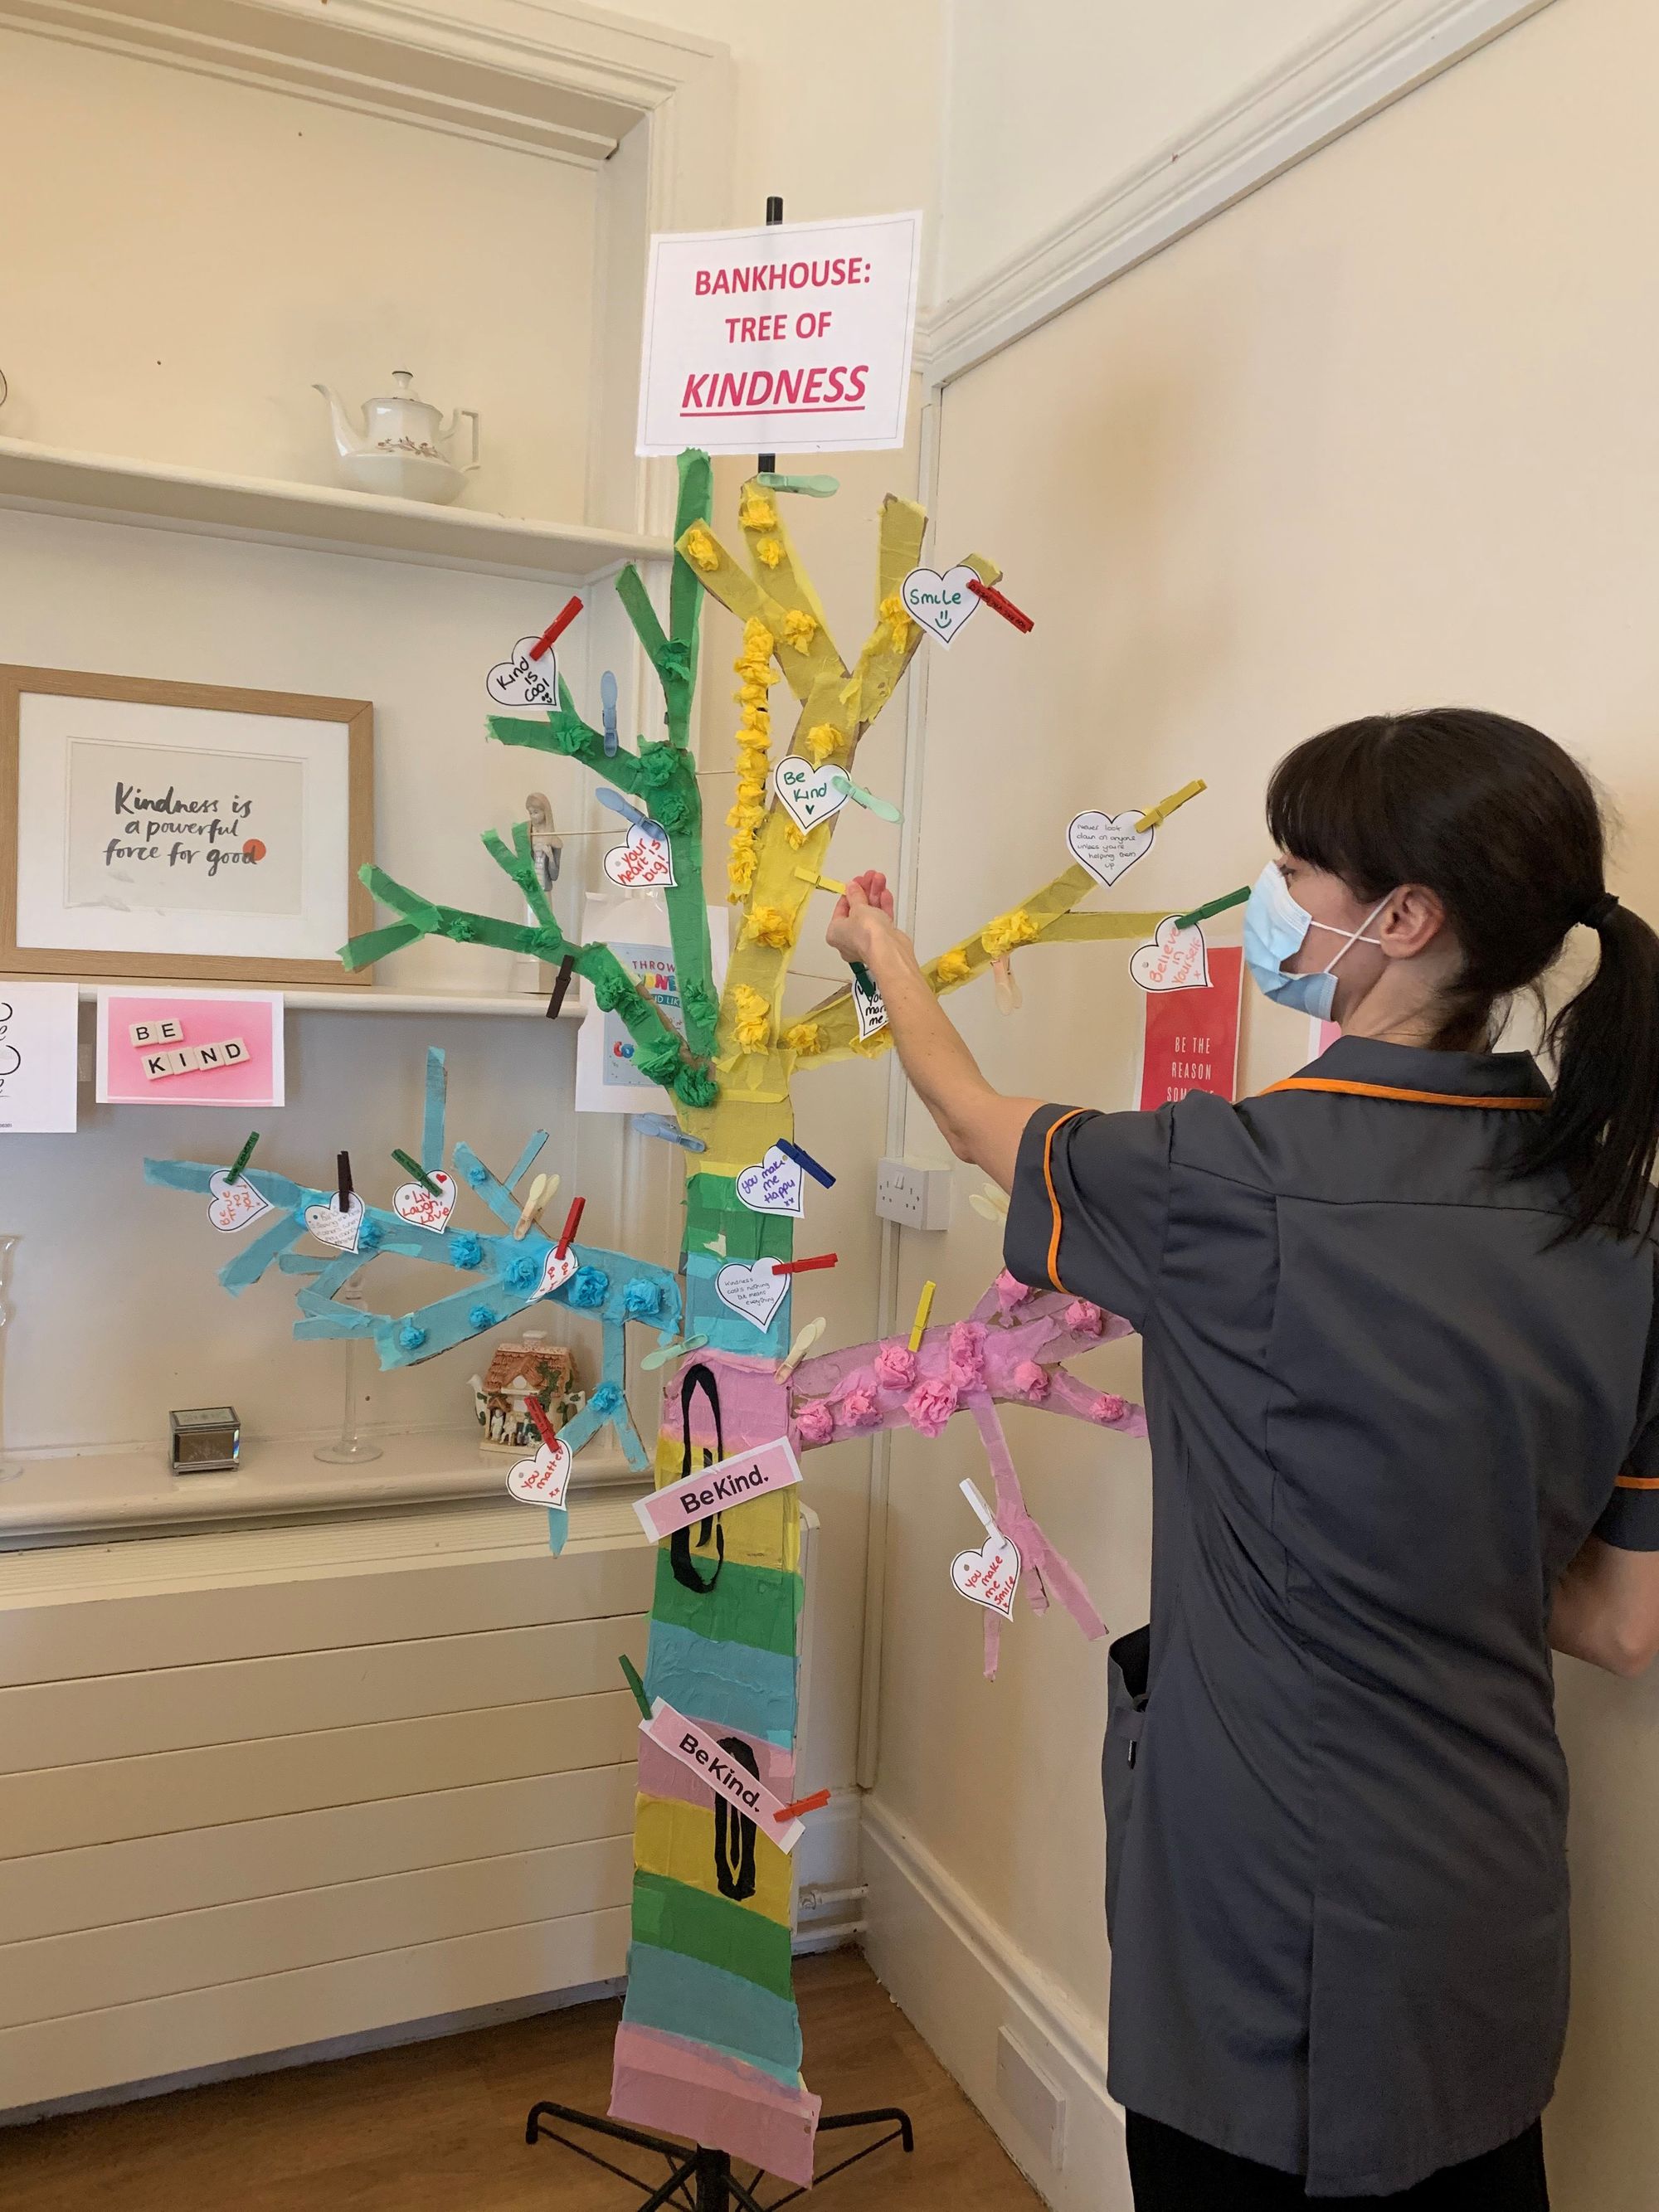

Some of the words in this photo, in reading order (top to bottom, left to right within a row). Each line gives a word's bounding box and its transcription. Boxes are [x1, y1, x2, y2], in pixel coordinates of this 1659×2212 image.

[695, 257, 871, 296] BANKHOUSE:
[725, 314, 787, 343] TREE
[795, 311, 832, 339] OF
[681, 365, 869, 408] KINDNESS
[496, 656, 529, 690] Kind
[524, 671, 538, 685] is
[784, 771, 805, 785] Be
[114, 781, 219, 814] Kindness
[231, 795, 252, 818] is
[794, 782, 827, 802] Kind
[124, 819, 140, 834] a
[146, 818, 238, 843] powerful
[1110, 836, 1136, 844] anyone
[103, 839, 161, 866] force
[168, 842, 201, 867] for
[207, 844, 258, 877] good
[617, 857, 649, 885] heart
[649, 839, 661, 855] is
[1088, 853, 1115, 862] helping
[1149, 927, 1181, 983] Believe
[1172, 951, 1185, 965] in
[632, 960, 676, 972] THROW
[869, 1015, 883, 1026] me
[136, 1023, 176, 1040] BE
[1175, 1037, 1186, 1053] BE
[1193, 1037, 1210, 1053] THE
[148, 1043, 241, 1074] KIND
[1172, 1062, 1211, 1080] REASON
[421, 1207, 450, 1224] Love
[747, 1282, 770, 1291] nothing
[679, 1490, 714, 1514] Be
[981, 1555, 1004, 1586] make
[985, 1580, 1000, 1598] me
[679, 1733, 709, 1765] Be
